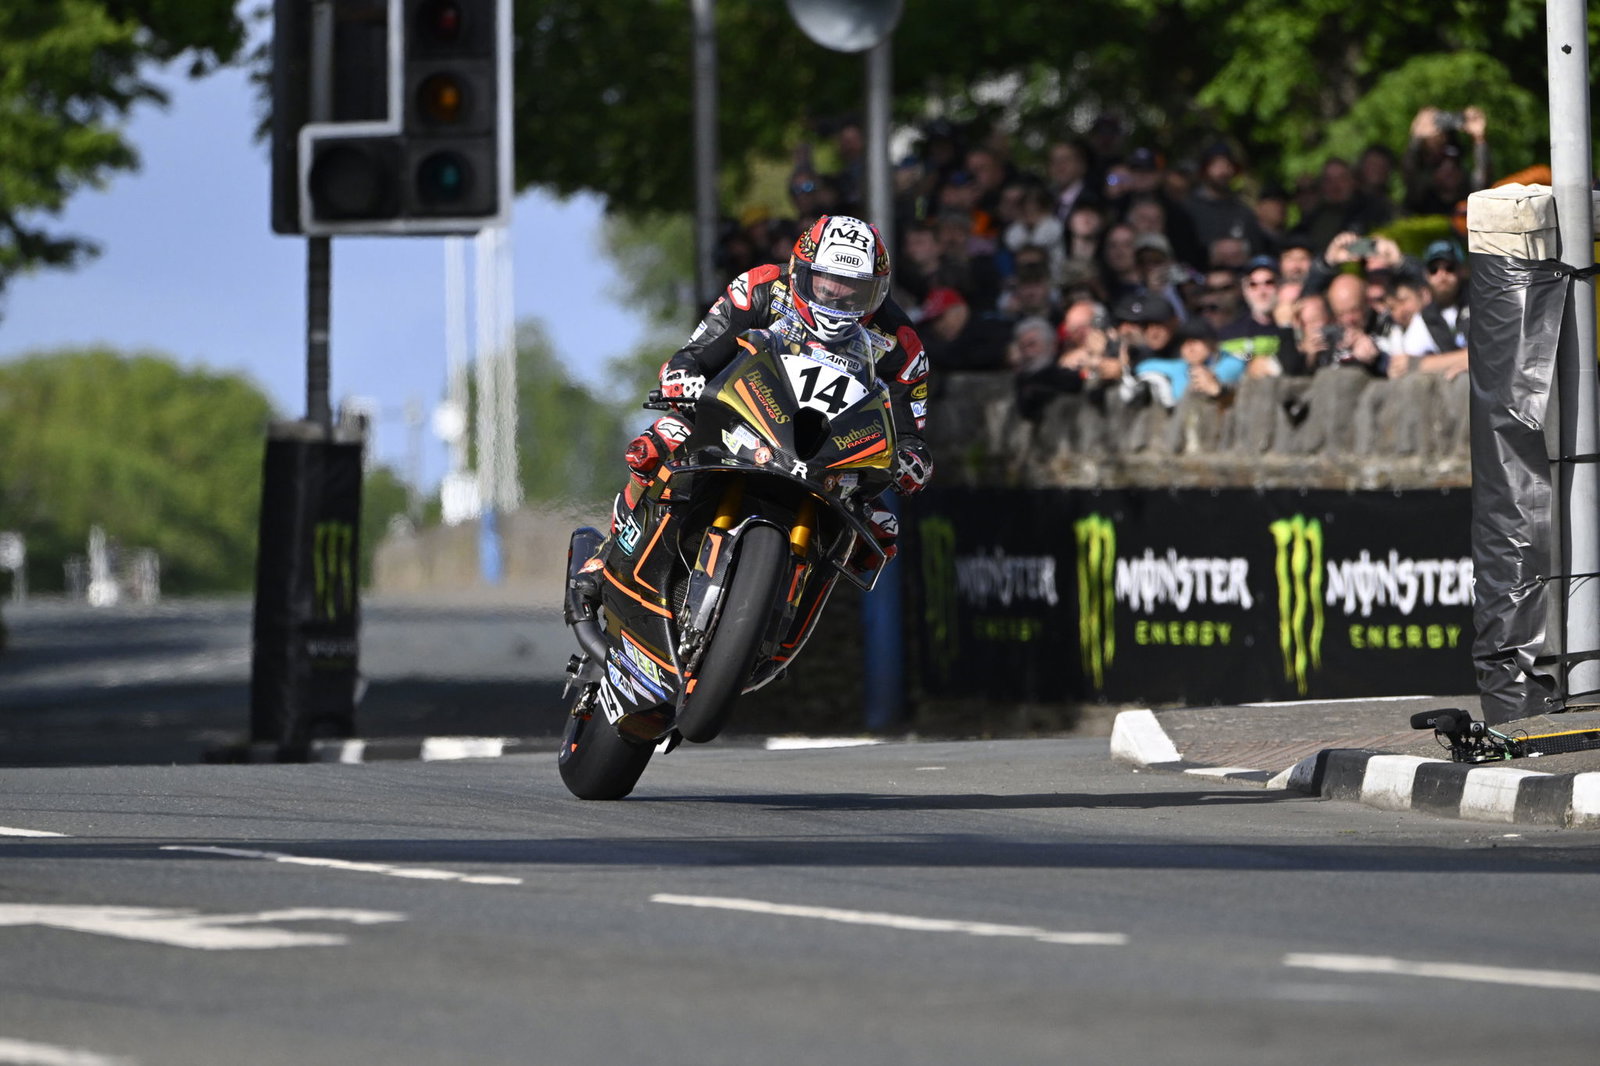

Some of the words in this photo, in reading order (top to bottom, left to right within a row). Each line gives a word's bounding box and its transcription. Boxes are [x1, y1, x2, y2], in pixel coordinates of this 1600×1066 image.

[834, 253, 860, 266] SHOEI
[825, 354, 848, 367] AJN
[749, 381, 777, 419] RACING
[799, 365, 850, 414] 14
[847, 432, 881, 449] RACING
[1115, 547, 1254, 614] MONSTER
[1326, 548, 1476, 617] MONSTER
[1135, 620, 1232, 646] ENERGY
[1349, 623, 1461, 649] ENERGY
